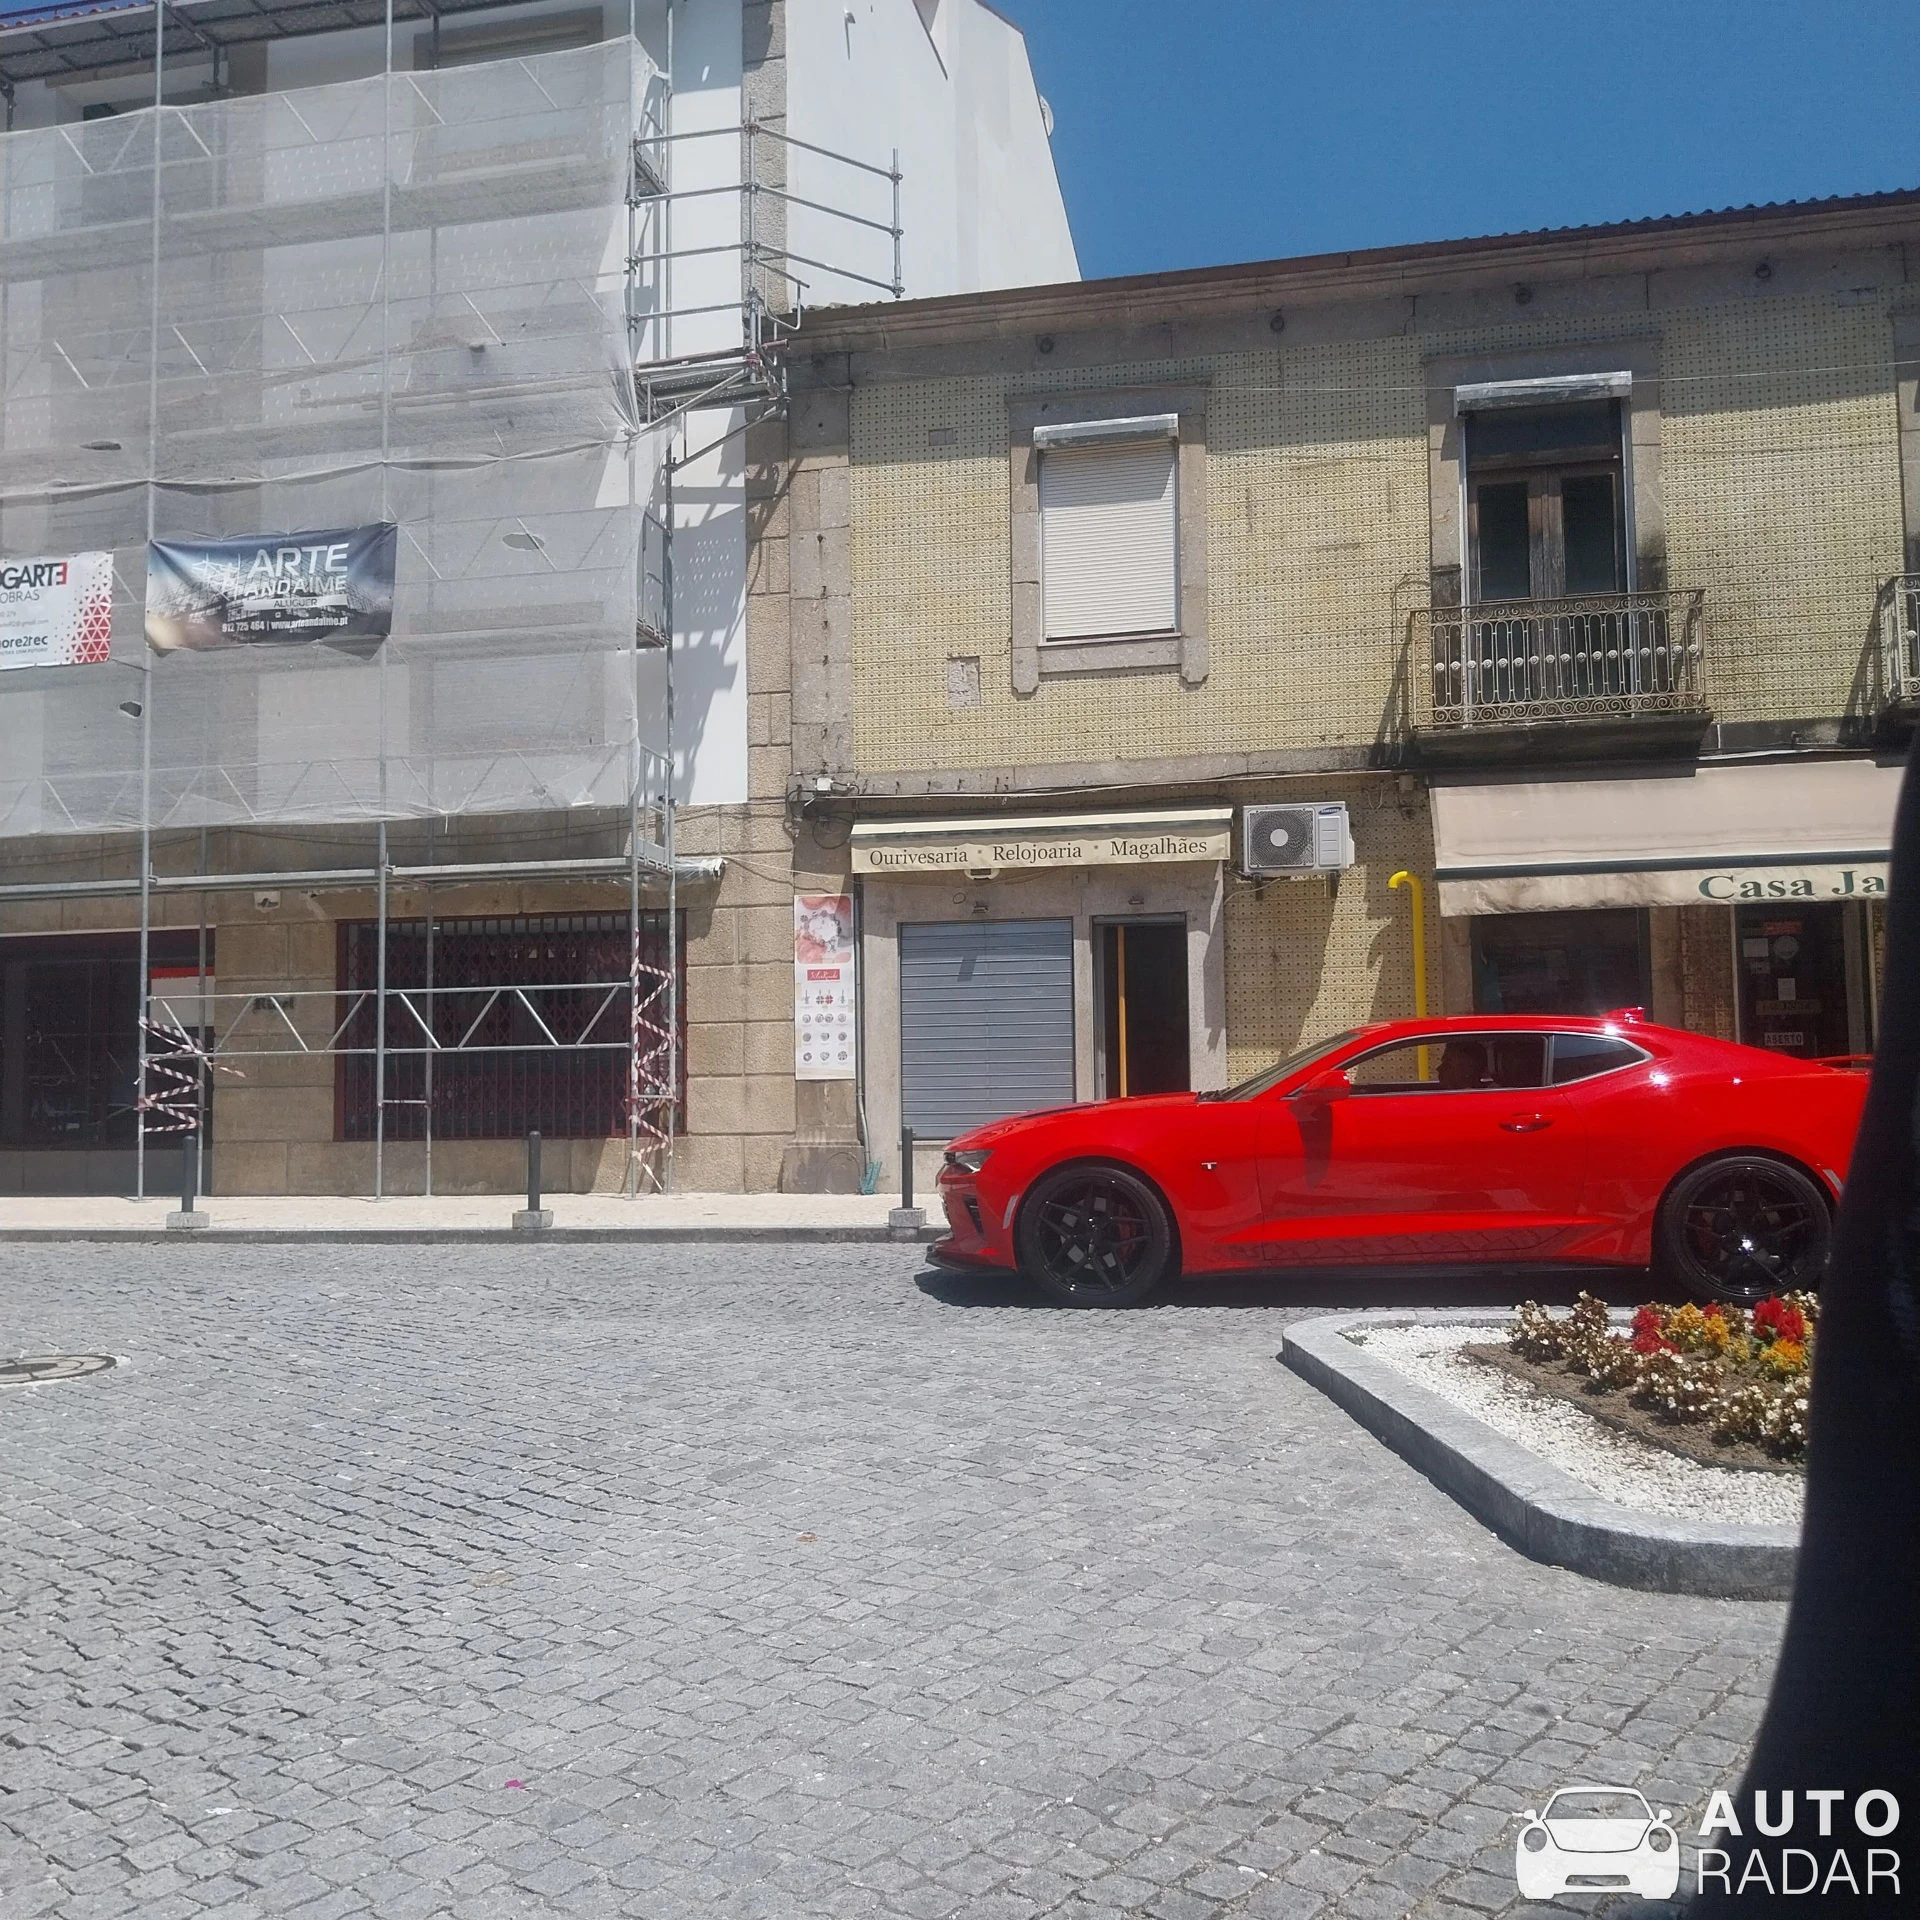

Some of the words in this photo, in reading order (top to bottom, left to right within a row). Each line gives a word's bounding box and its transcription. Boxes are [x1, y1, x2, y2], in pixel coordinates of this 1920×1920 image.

[247, 543, 349, 579] ARTE
[0, 562, 67, 590] GARTE
[244, 575, 347, 597] ANDAIME
[0, 589, 40, 604] OBRAS
[273, 598, 318, 608] ALUGUER
[222, 621, 235, 632] 912
[236, 620, 249, 631] 725
[0, 635, 48, 649] ore2tec
[869, 849, 968, 867] Ourivesaria
[992, 842, 1082, 864] Relojoaria
[1110, 838, 1207, 861] Magalhães
[1698, 875, 1816, 900] Casa
[1831, 870, 1889, 896] Ja
[1765, 1033, 1802, 1045] ABERTO
